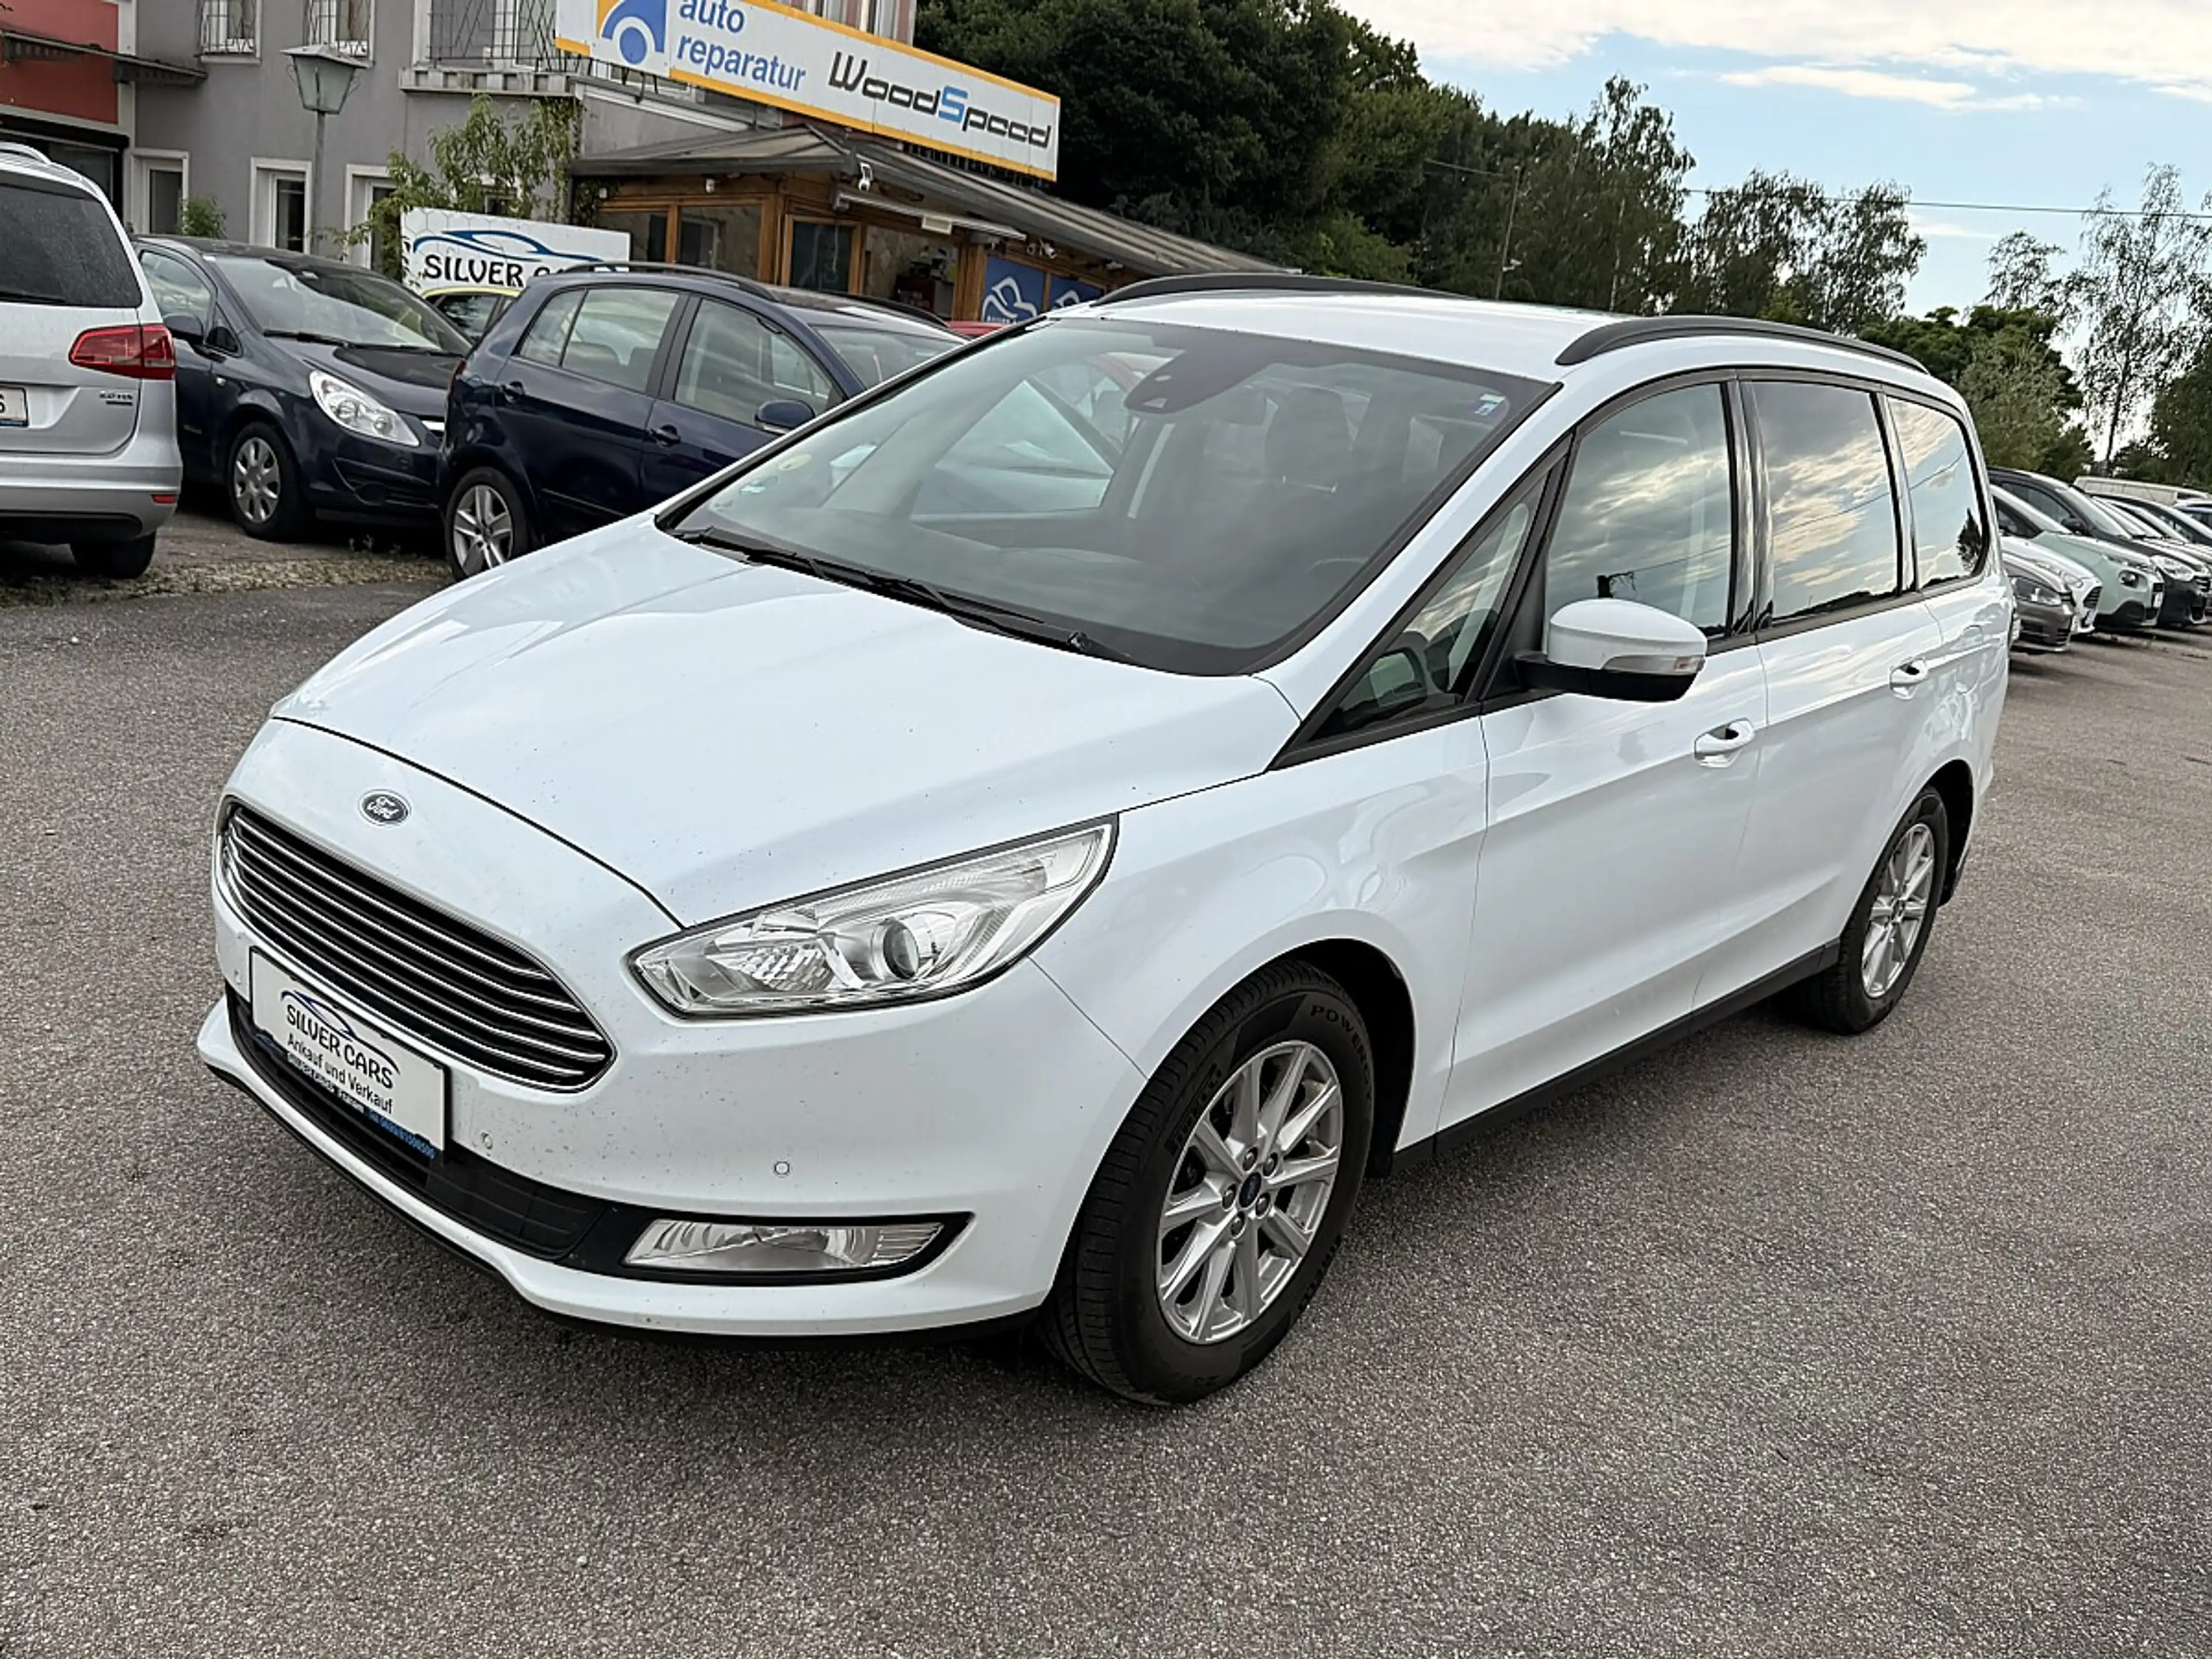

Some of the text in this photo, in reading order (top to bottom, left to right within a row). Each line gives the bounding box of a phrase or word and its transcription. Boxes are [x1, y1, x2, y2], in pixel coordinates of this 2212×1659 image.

[680, 0, 744, 33] auto
[677, 35, 806, 91] reparatur
[828, 51, 1051, 149] WoodSpeed
[425, 254, 524, 287] SILVER
[287, 1005, 341, 1057] SILVER
[344, 1044, 393, 1089] CARS
[288, 1033, 323, 1068] Ankauf
[325, 1062, 345, 1084] und
[349, 1072, 392, 1114] Verkauf
